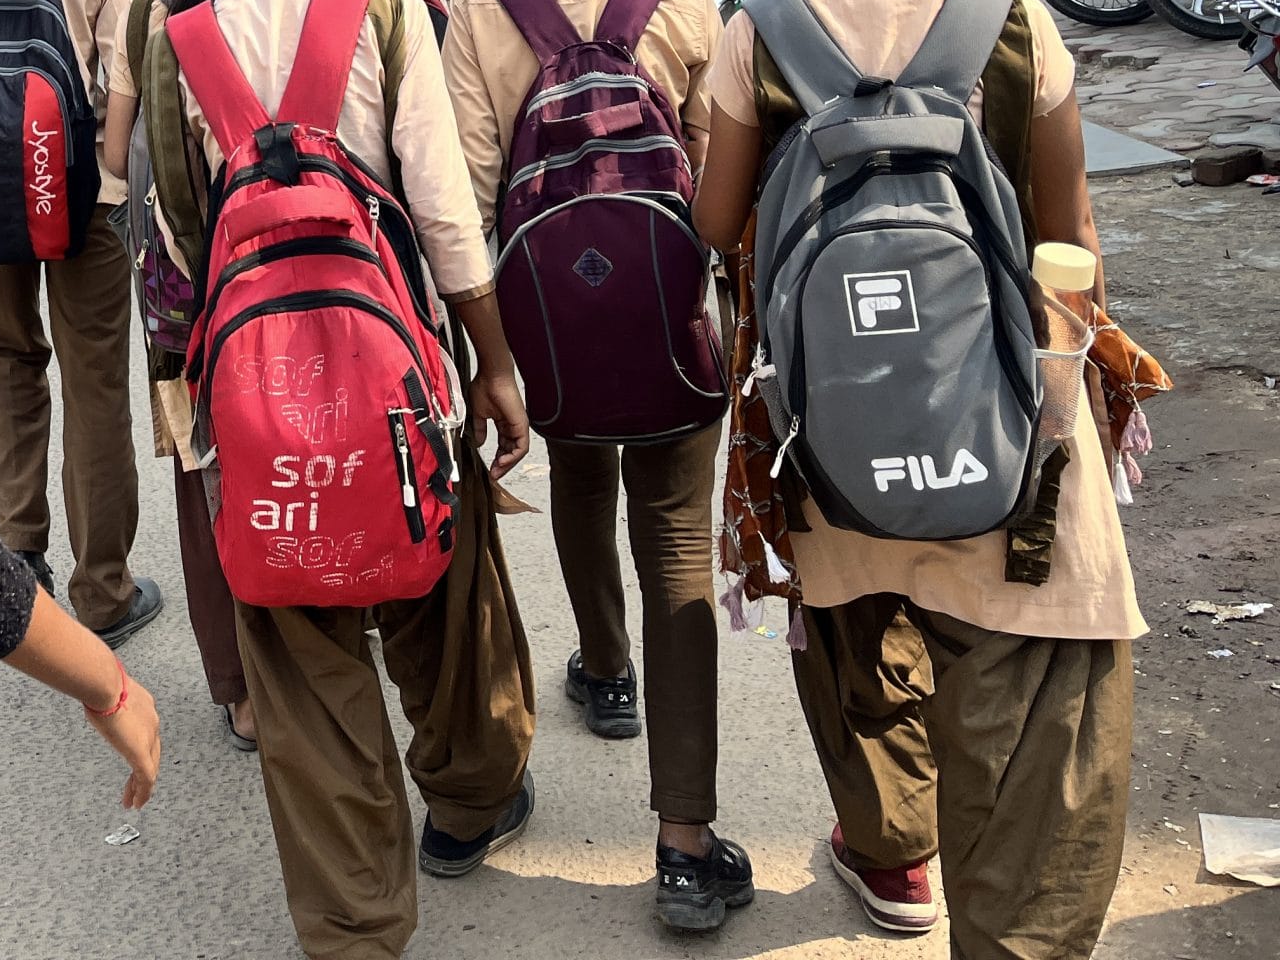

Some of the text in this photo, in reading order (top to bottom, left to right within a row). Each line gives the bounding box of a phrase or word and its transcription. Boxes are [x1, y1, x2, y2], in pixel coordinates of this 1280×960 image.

[28, 120, 58, 215] Jyostyle
[871, 448, 989, 492] FILA
[250, 491, 319, 532] ari
